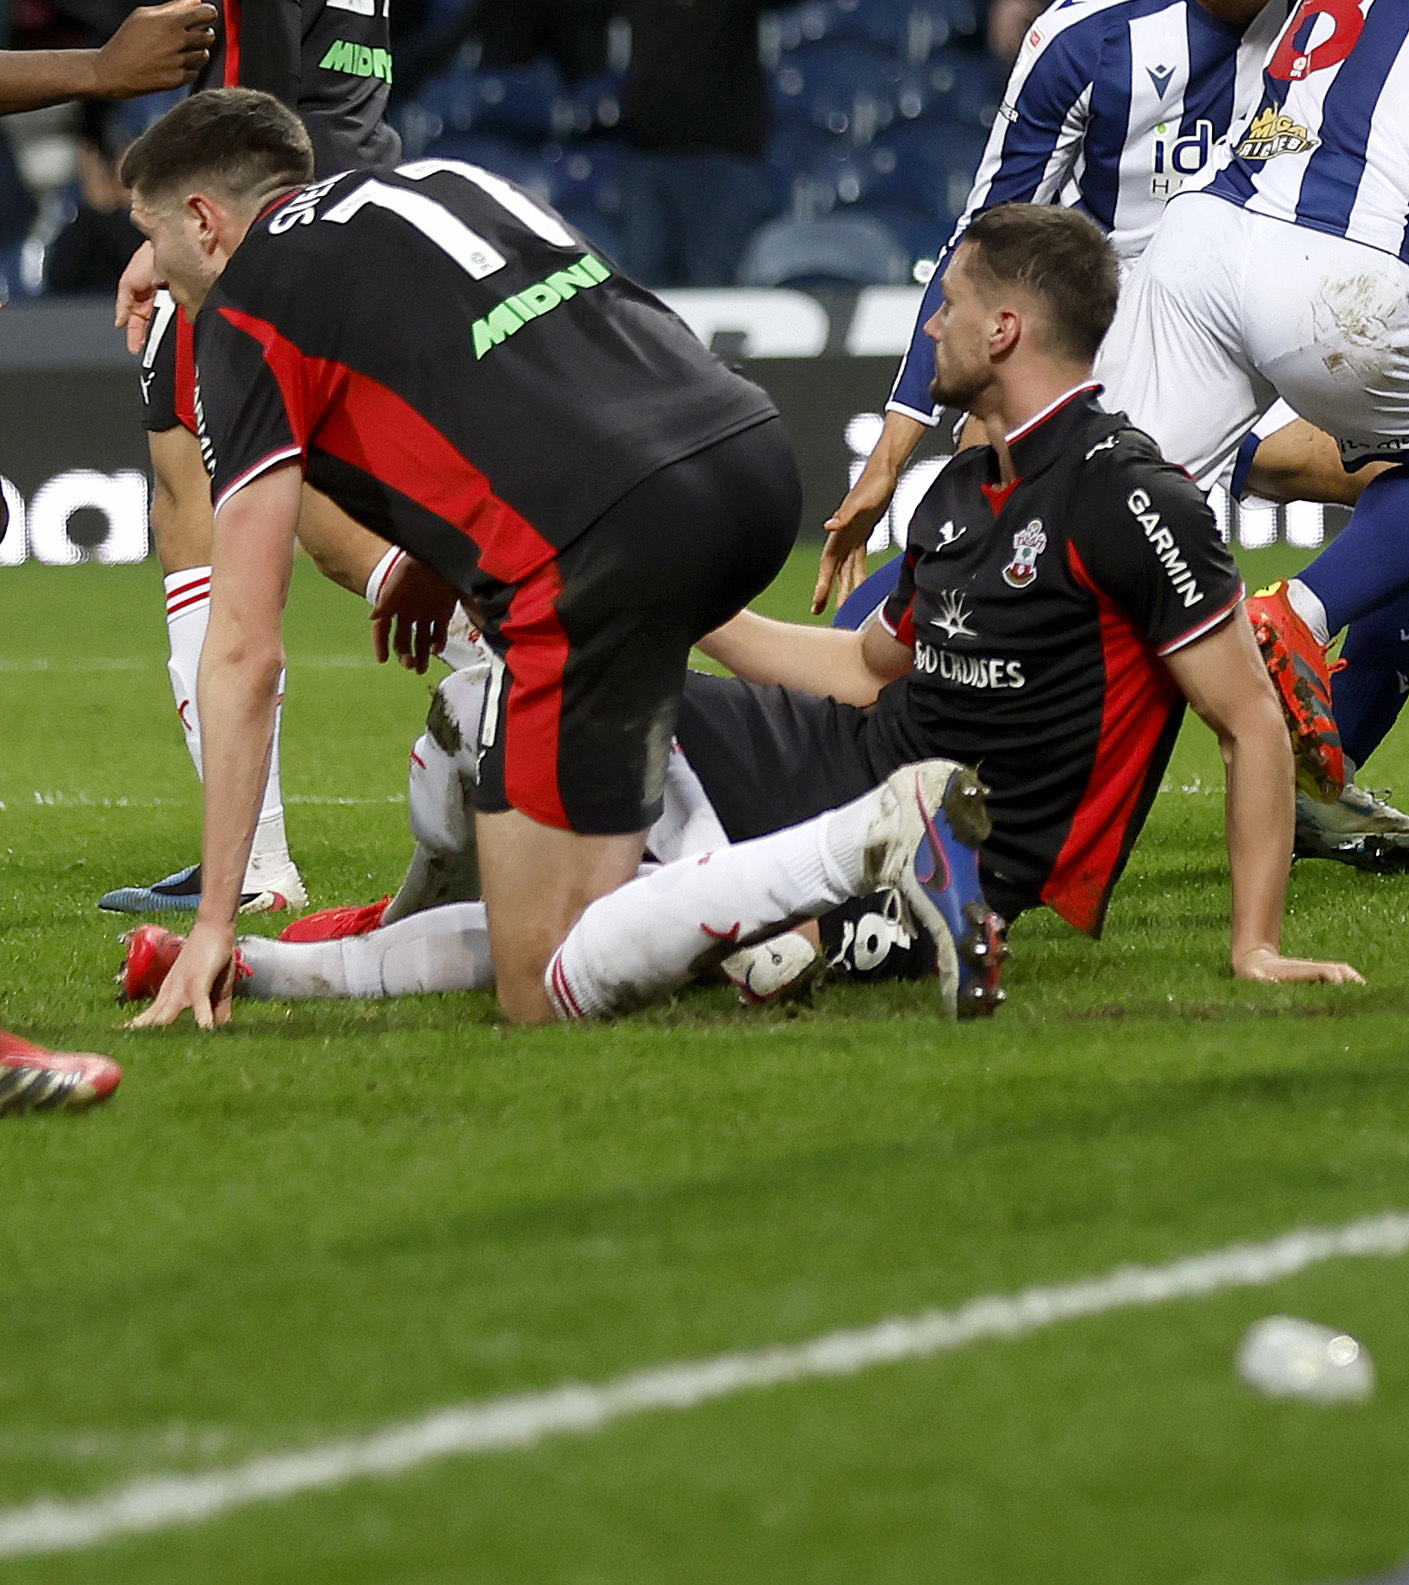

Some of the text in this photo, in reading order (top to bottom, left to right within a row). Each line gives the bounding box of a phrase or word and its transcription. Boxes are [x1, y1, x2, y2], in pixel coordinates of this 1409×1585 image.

[318, 38, 393, 85] MIDN
[320, 157, 576, 281] 11
[471, 252, 613, 362] MIDNI
[1125, 487, 1205, 609] GARMIN
[939, 647, 1027, 690] CRUISES
